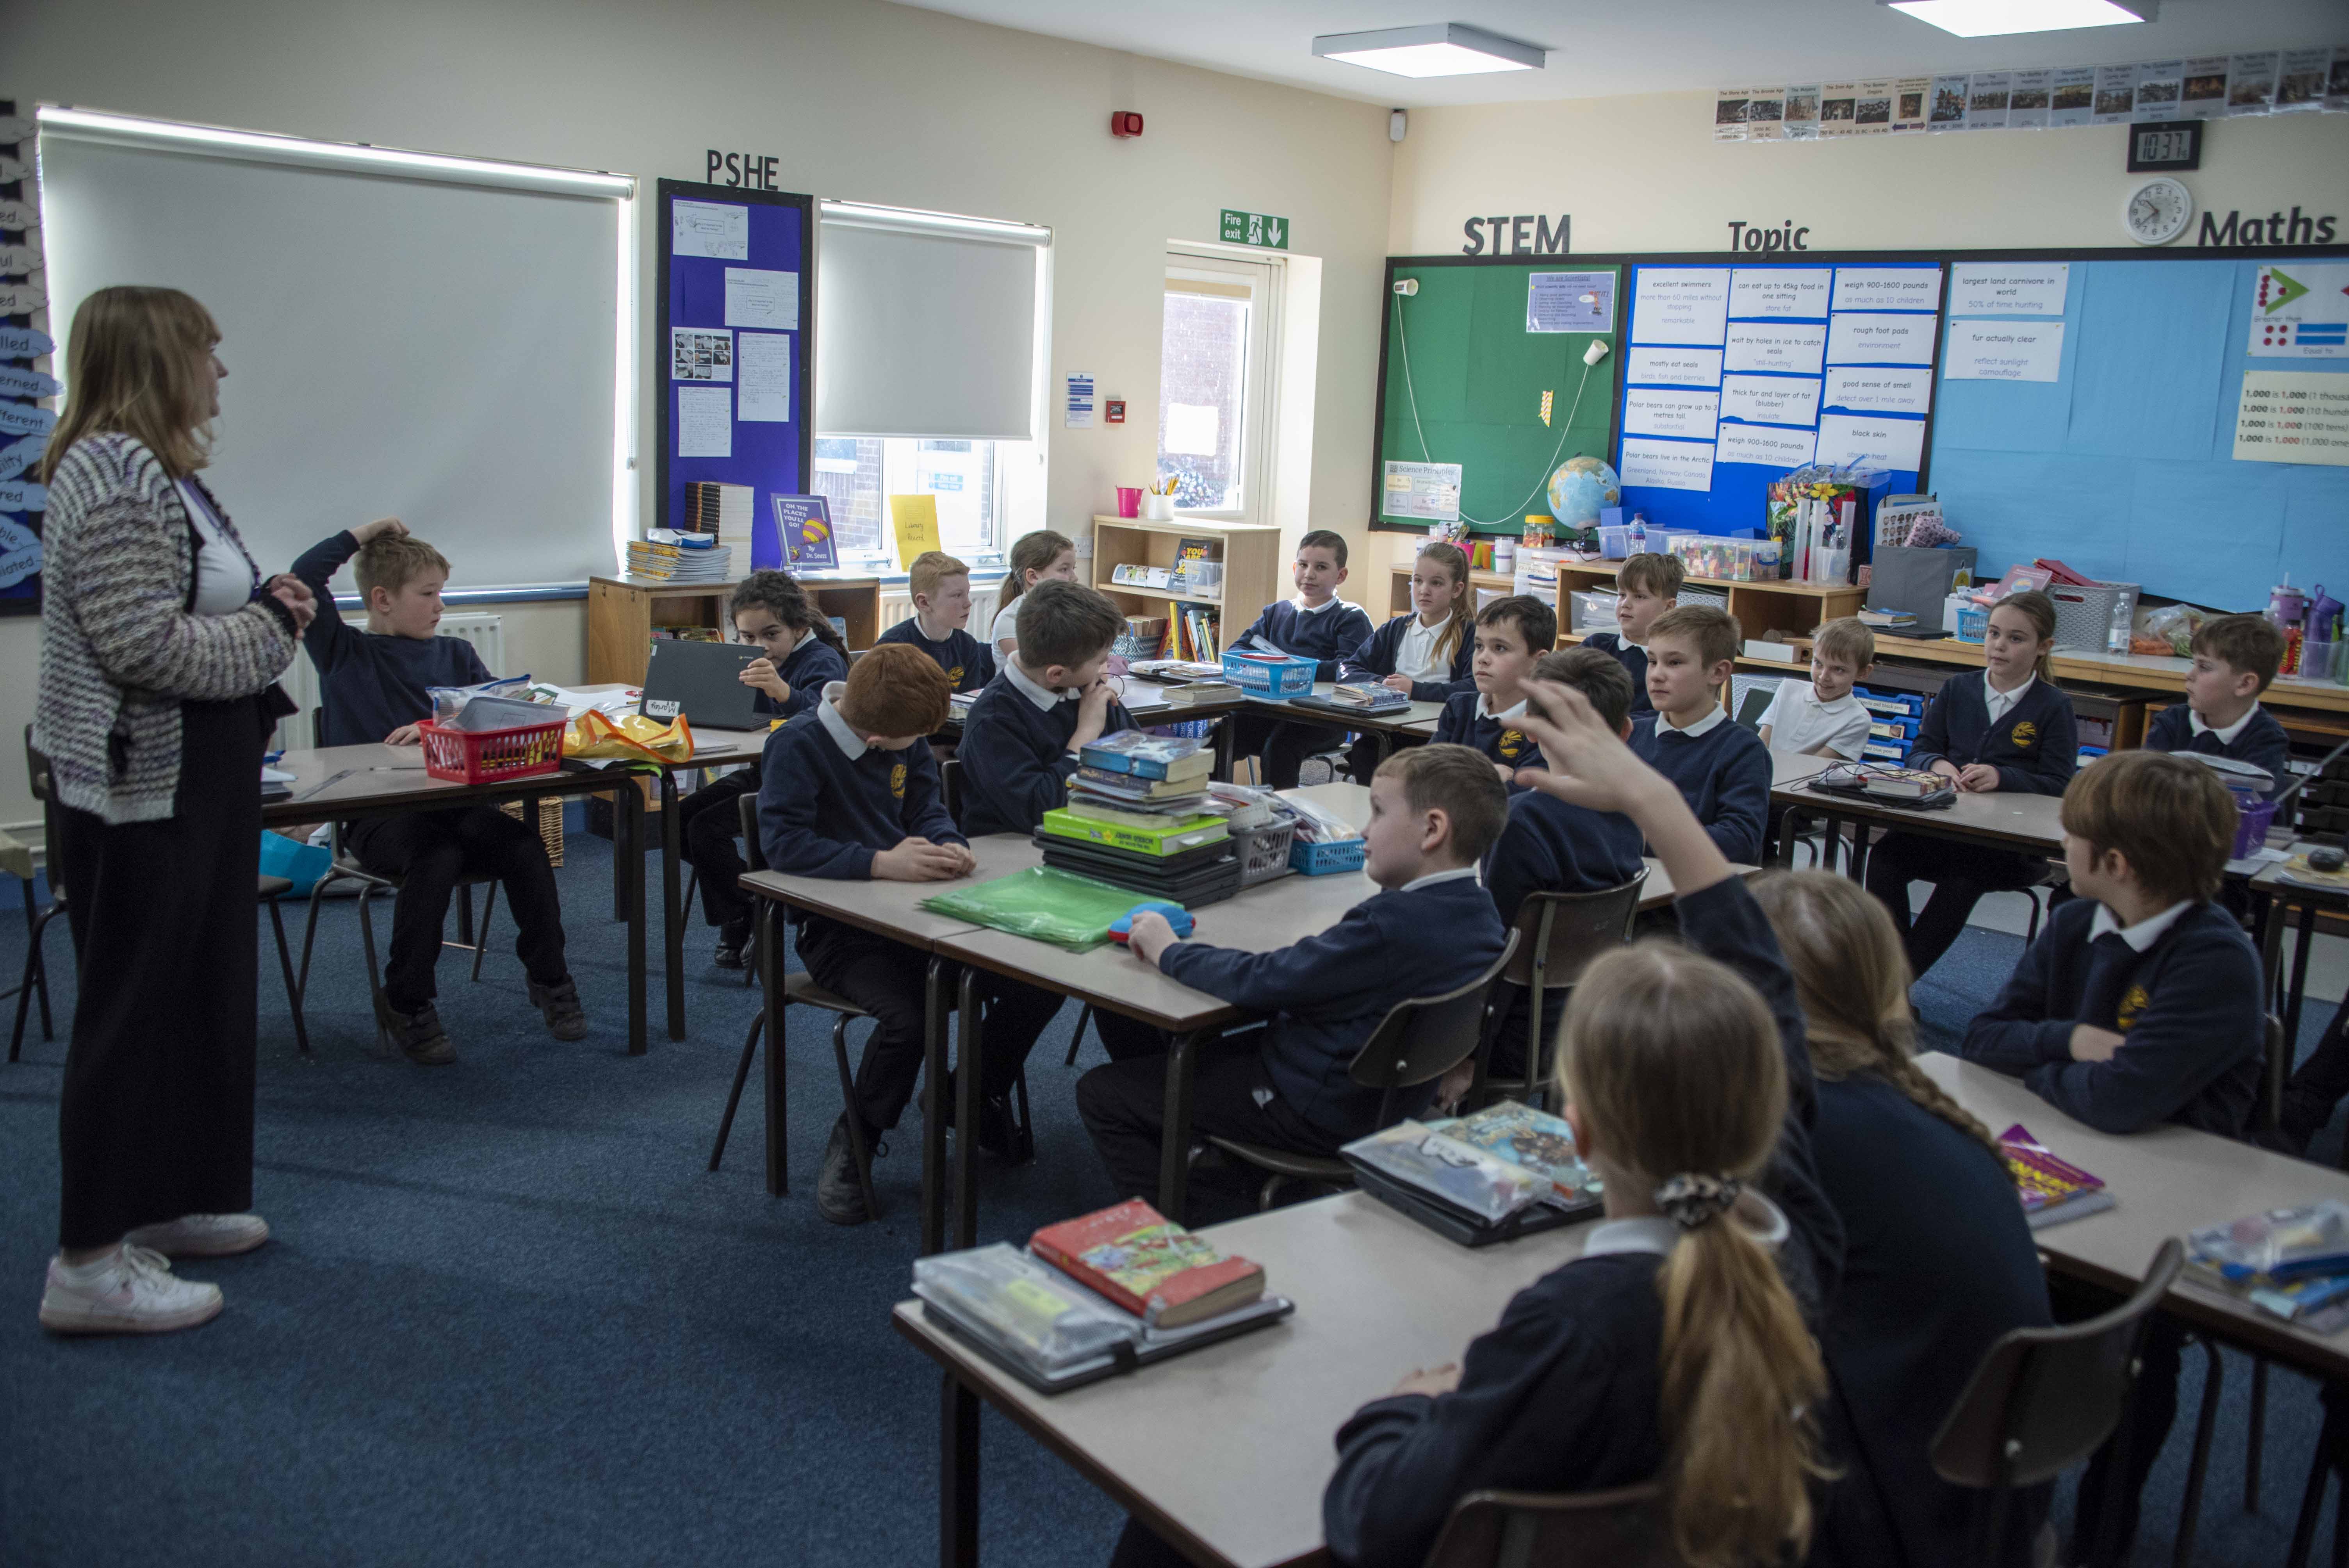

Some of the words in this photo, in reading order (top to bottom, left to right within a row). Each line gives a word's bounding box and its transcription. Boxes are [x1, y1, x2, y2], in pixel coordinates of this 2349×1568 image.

[707, 150, 779, 191] PSHE
[1225, 213, 1241, 225] Fire
[2198, 206, 2337, 246] Maths
[1225, 229, 1241, 239] exit
[1463, 214, 1571, 255] STEM
[1728, 220, 1810, 252] Topic
[1845, 282, 1864, 290] weigh
[1962, 278, 1988, 286] largest
[1783, 283, 1798, 291] 45kg
[2015, 301, 2043, 310] hunting
[1853, 327, 1873, 335] rough
[1985, 335, 2015, 344] actually
[1974, 357, 1998, 365] reflect
[2000, 359, 2029, 367] sunlight
[1979, 369, 2021, 377] camouflage
[1775, 391, 1791, 399] layer
[2246, 390, 2271, 398] 1,000
[2282, 391, 2307, 399] 1,000
[1756, 400, 1784, 408] (blubber)
[2243, 404, 2268, 413] 1,000
[2279, 406, 2304, 415] 1,000
[1852, 429, 1870, 437] black
[1390, 465, 1398, 473] BB
[1399, 465, 1422, 474] Science
[783, 509, 806, 517] PLACES
[905, 521, 924, 531] Library
[907, 533, 925, 542] Record
[651, 702, 676, 714] Marley
